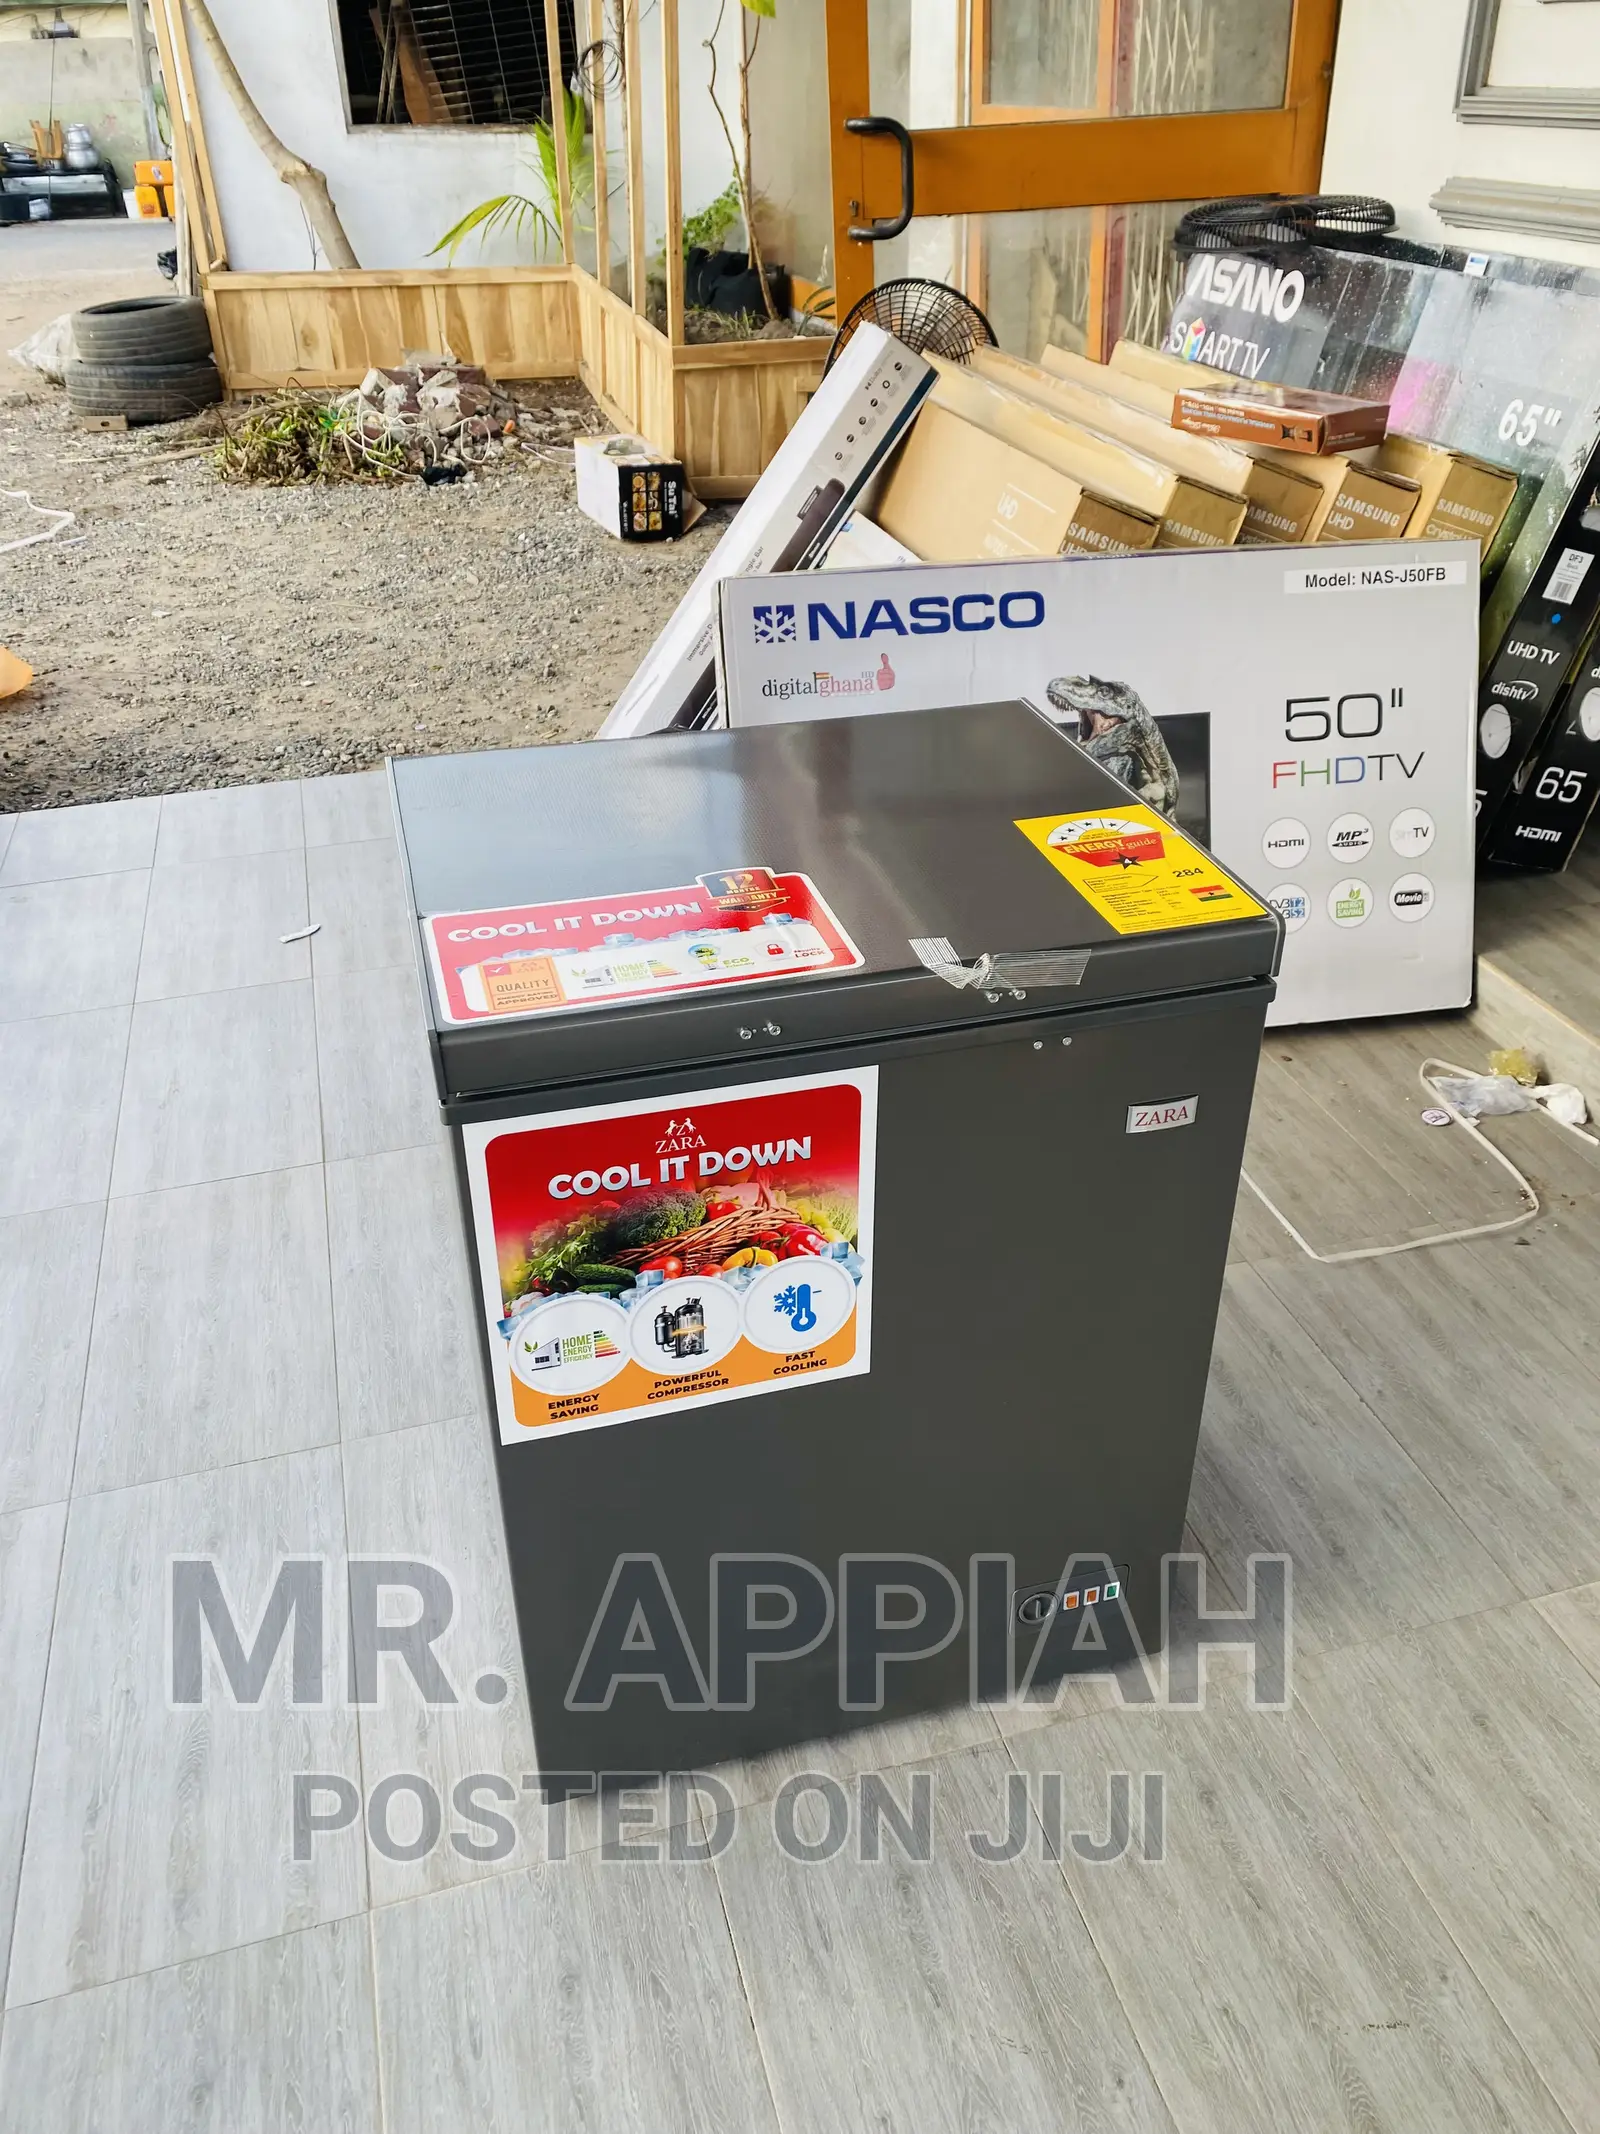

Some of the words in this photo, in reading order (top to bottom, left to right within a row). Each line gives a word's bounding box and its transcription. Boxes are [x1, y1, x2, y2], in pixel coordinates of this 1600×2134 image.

[1187, 255, 1305, 323] ASANO
[1171, 317, 1243, 372] SMART
[1241, 341, 1271, 380] TV
[1498, 399, 1562, 446] 65"
[1248, 505, 1298, 533] AMSUNG
[1335, 493, 1400, 527] SAMSUNG
[1437, 498, 1495, 527] SAMSUNG
[1327, 510, 1355, 530] UHD
[1305, 573, 1356, 588] Model:
[1361, 567, 1447, 585] NAS-J50FB
[808, 590, 1045, 641] NASCO
[1507, 640, 1539, 660] UHD
[1539, 648, 1561, 665] TV
[1285, 687, 1404, 742] 50"
[1536, 766, 1588, 803] 65
[1268, 838, 1304, 848] HDMI
[1515, 825, 1563, 843] HDMI
[1063, 838, 1125, 854] ENERGY
[1125, 838, 1158, 850] guide
[1172, 867, 1204, 878] 284
[719, 873, 754, 892] 12
[719, 892, 778, 905] WARRANTY
[1338, 900, 1364, 909] ENERGY
[1396, 893, 1423, 903] Movie
[447, 919, 547, 942] COOL
[554, 913, 584, 931] IT
[590, 901, 703, 928] DOWN
[1337, 908, 1364, 918] SAVING
[722, 957, 750, 965] ECO
[496, 979, 550, 993] QUALITY
[497, 994, 559, 1006] APPROVED
[1135, 1103, 1190, 1127] ZARA
[655, 1134, 708, 1154] ZARA
[548, 1166, 652, 1200] COOL
[659, 1155, 694, 1184] IT
[699, 1135, 812, 1178] DOWN
[562, 1334, 592, 1349] HOME
[563, 1345, 593, 1357] ENERGY
[563, 1353, 594, 1364] EFFICIENCY
[785, 1350, 816, 1363] FAST
[773, 1358, 828, 1375] COOLING
[647, 1378, 729, 1400] COMPRESSOR
[654, 1370, 722, 1389] POWERFUL
[548, 1393, 600, 1410] ENERGY
[550, 1404, 600, 1420] SAVING
